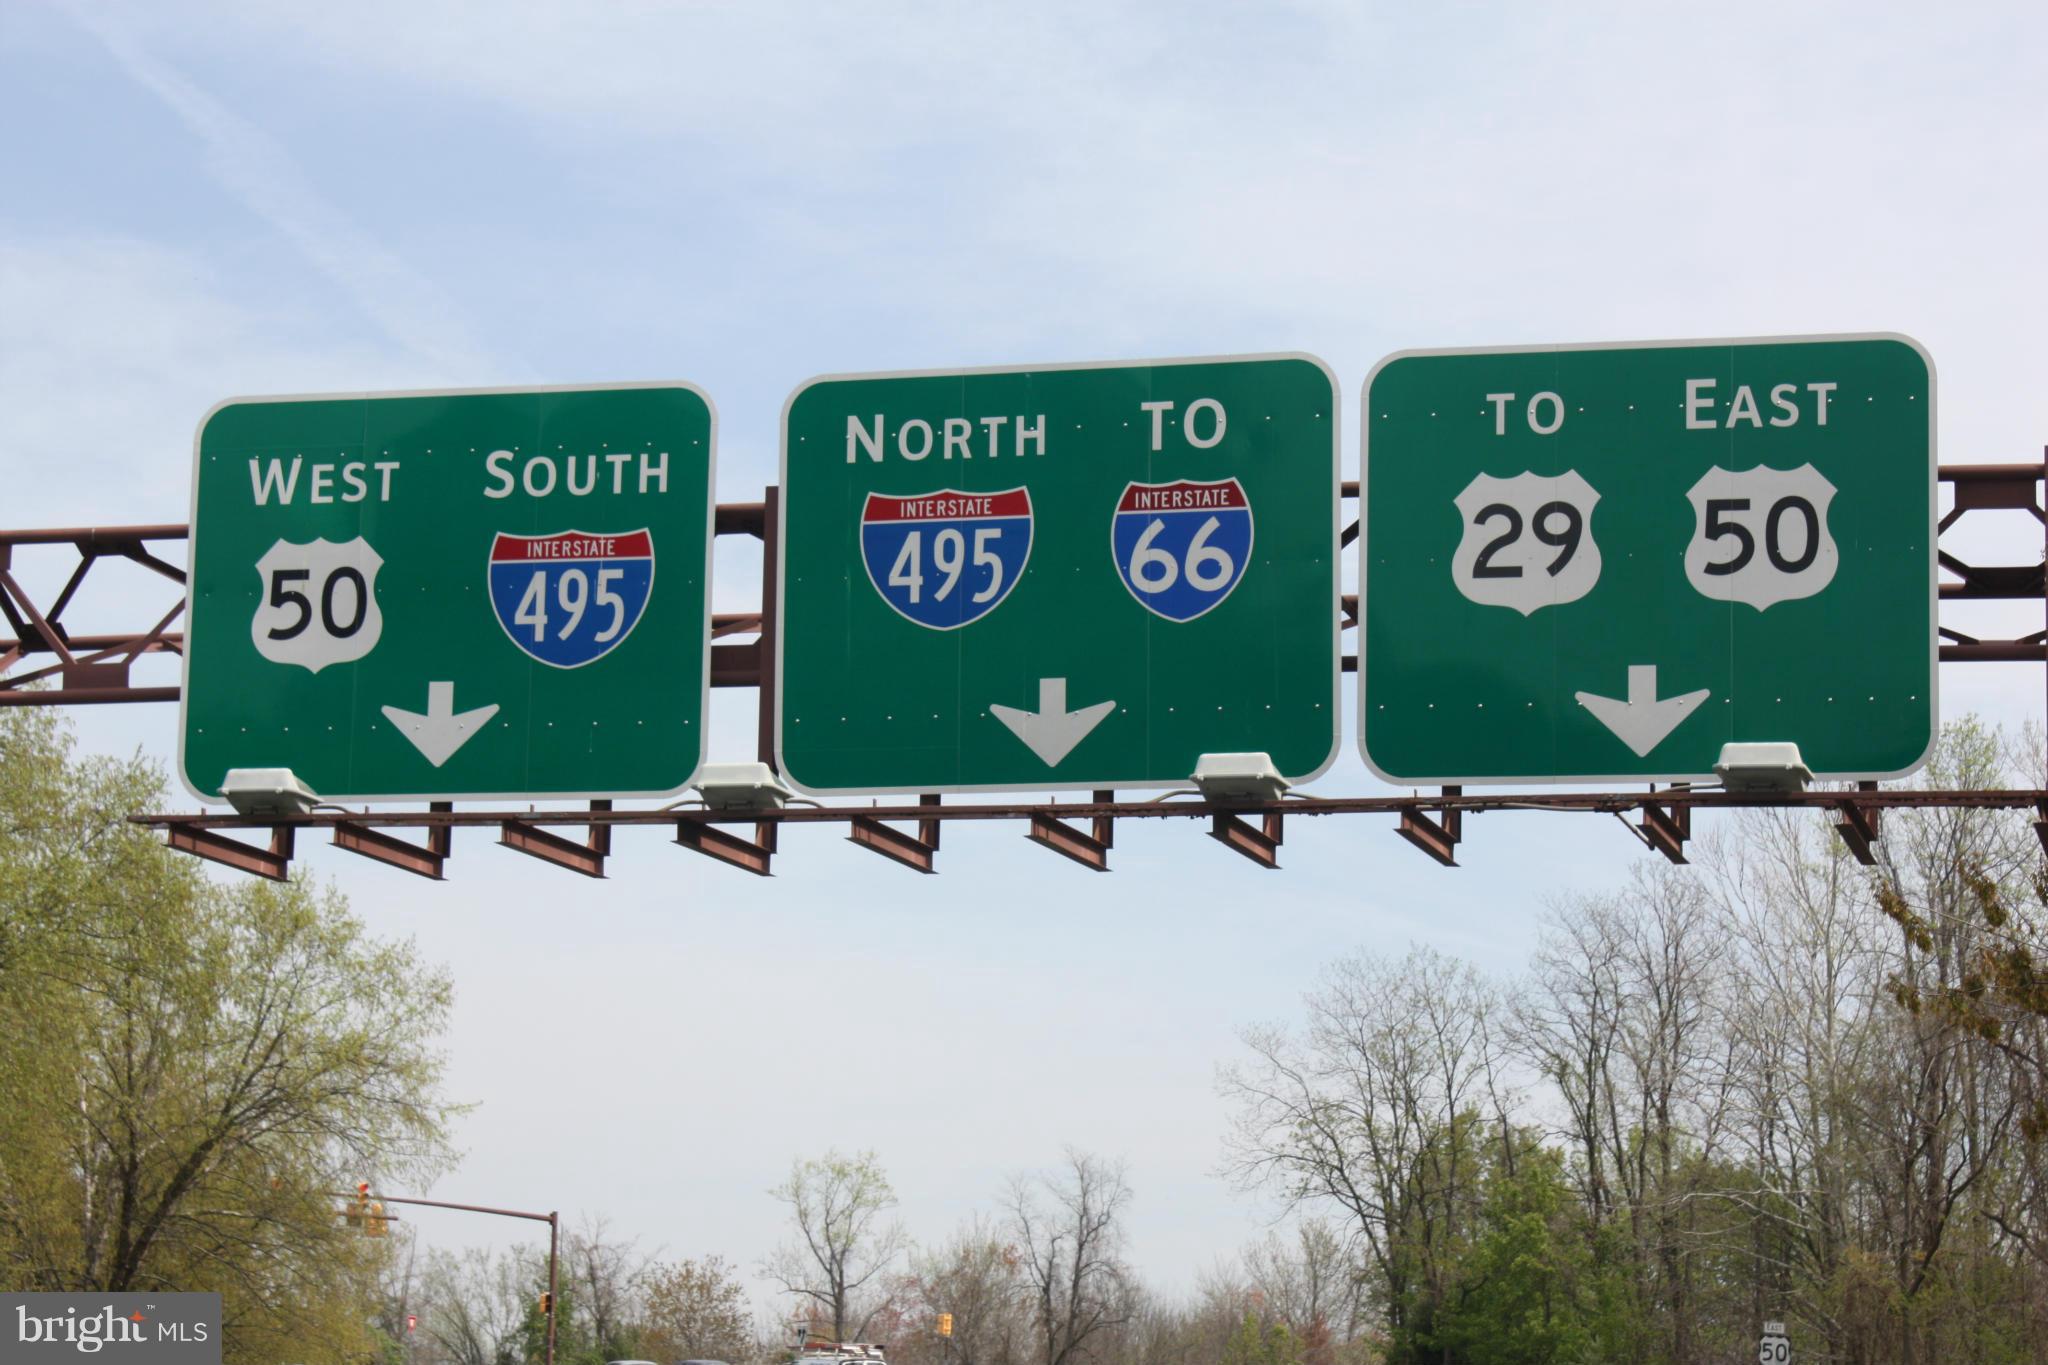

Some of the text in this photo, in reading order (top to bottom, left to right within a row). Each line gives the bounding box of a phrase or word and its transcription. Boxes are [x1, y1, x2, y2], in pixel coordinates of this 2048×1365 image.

[1141, 398, 1227, 451] TO
[1486, 391, 1566, 436] TO
[1685, 378, 1838, 430] EAST
[845, 413, 1047, 464] NORTH
[248, 457, 401, 506] WEST
[483, 449, 670, 499] SOUTH
[1134, 488, 1231, 510] INTERSTATE
[899, 498, 994, 518] INTERSTATE
[526, 538, 617, 558] INTERSTATE
[1129, 516, 1235, 594] 66
[1471, 500, 1584, 580] 29
[1702, 495, 1821, 577] 50
[888, 527, 1004, 604] 495
[267, 565, 368, 641] 50
[513, 568, 626, 644] 495
[1762, 1343, 1787, 1362] 50
